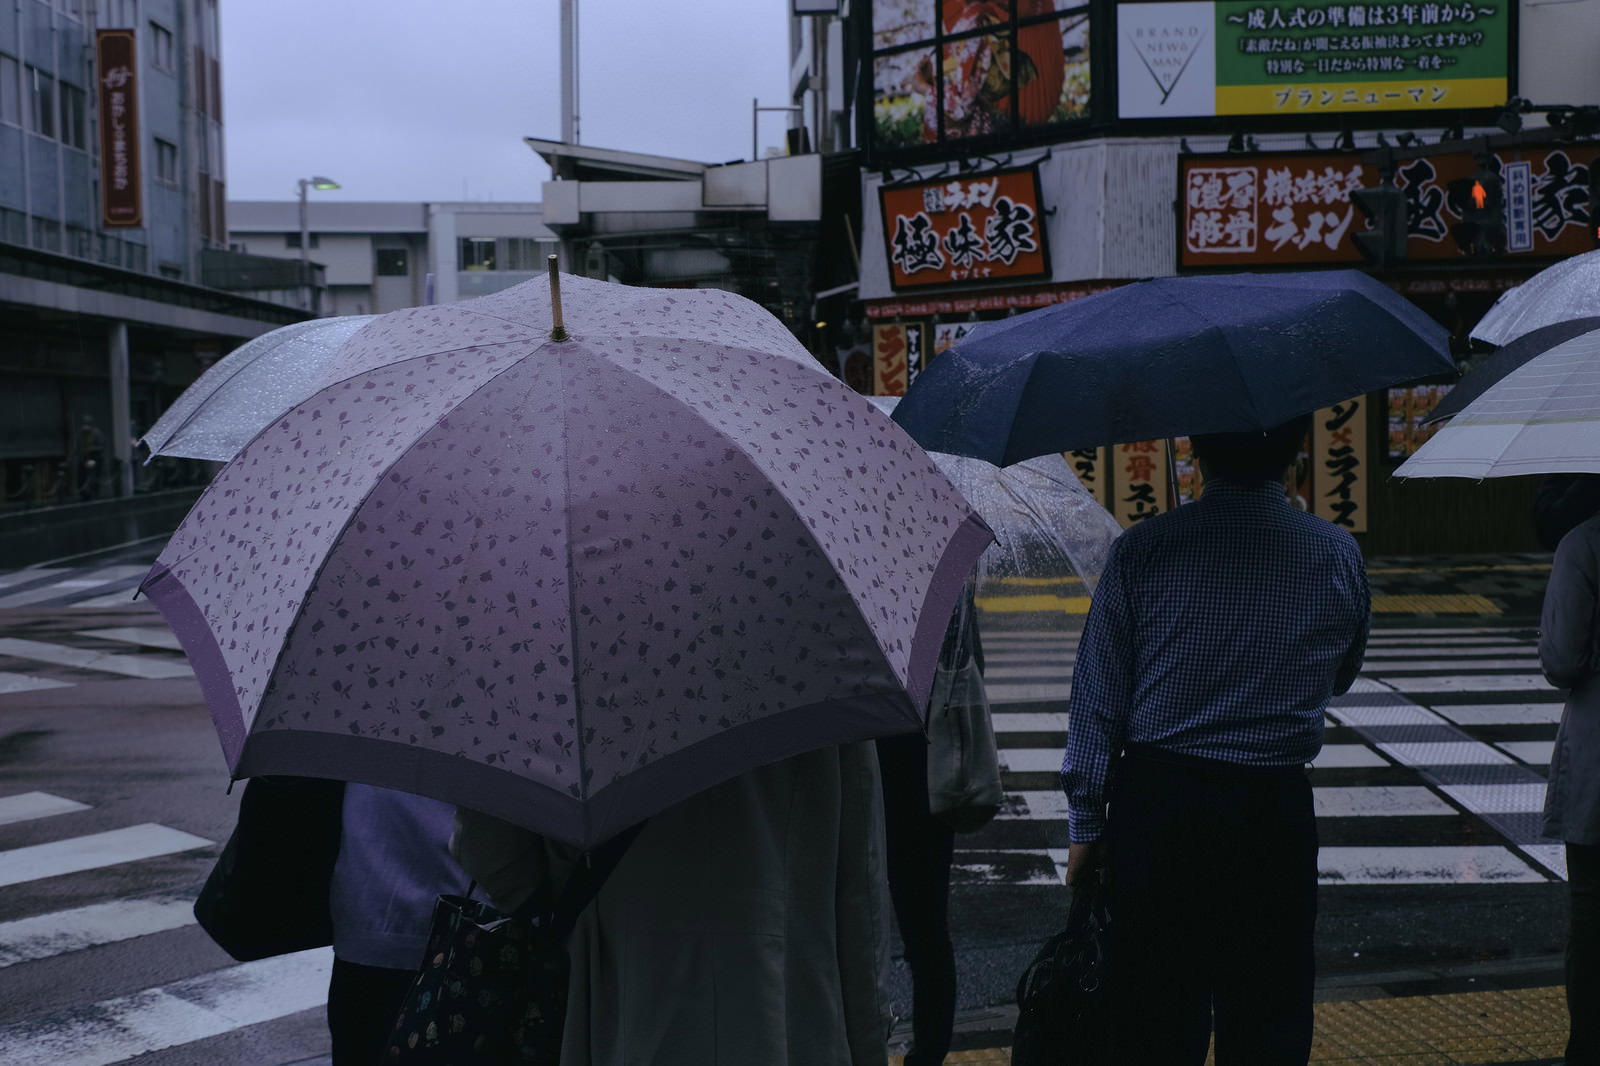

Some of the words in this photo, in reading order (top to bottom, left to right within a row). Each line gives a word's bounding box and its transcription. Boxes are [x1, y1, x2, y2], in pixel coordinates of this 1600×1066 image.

[1136, 26, 1199, 38] BRAND
[1275, 86, 1448, 107] ブランニューマン
[1264, 205, 1355, 253] ラーメン
[1512, 170, 1526, 245] 斜め横断専用
[893, 197, 1037, 274] 極味家
